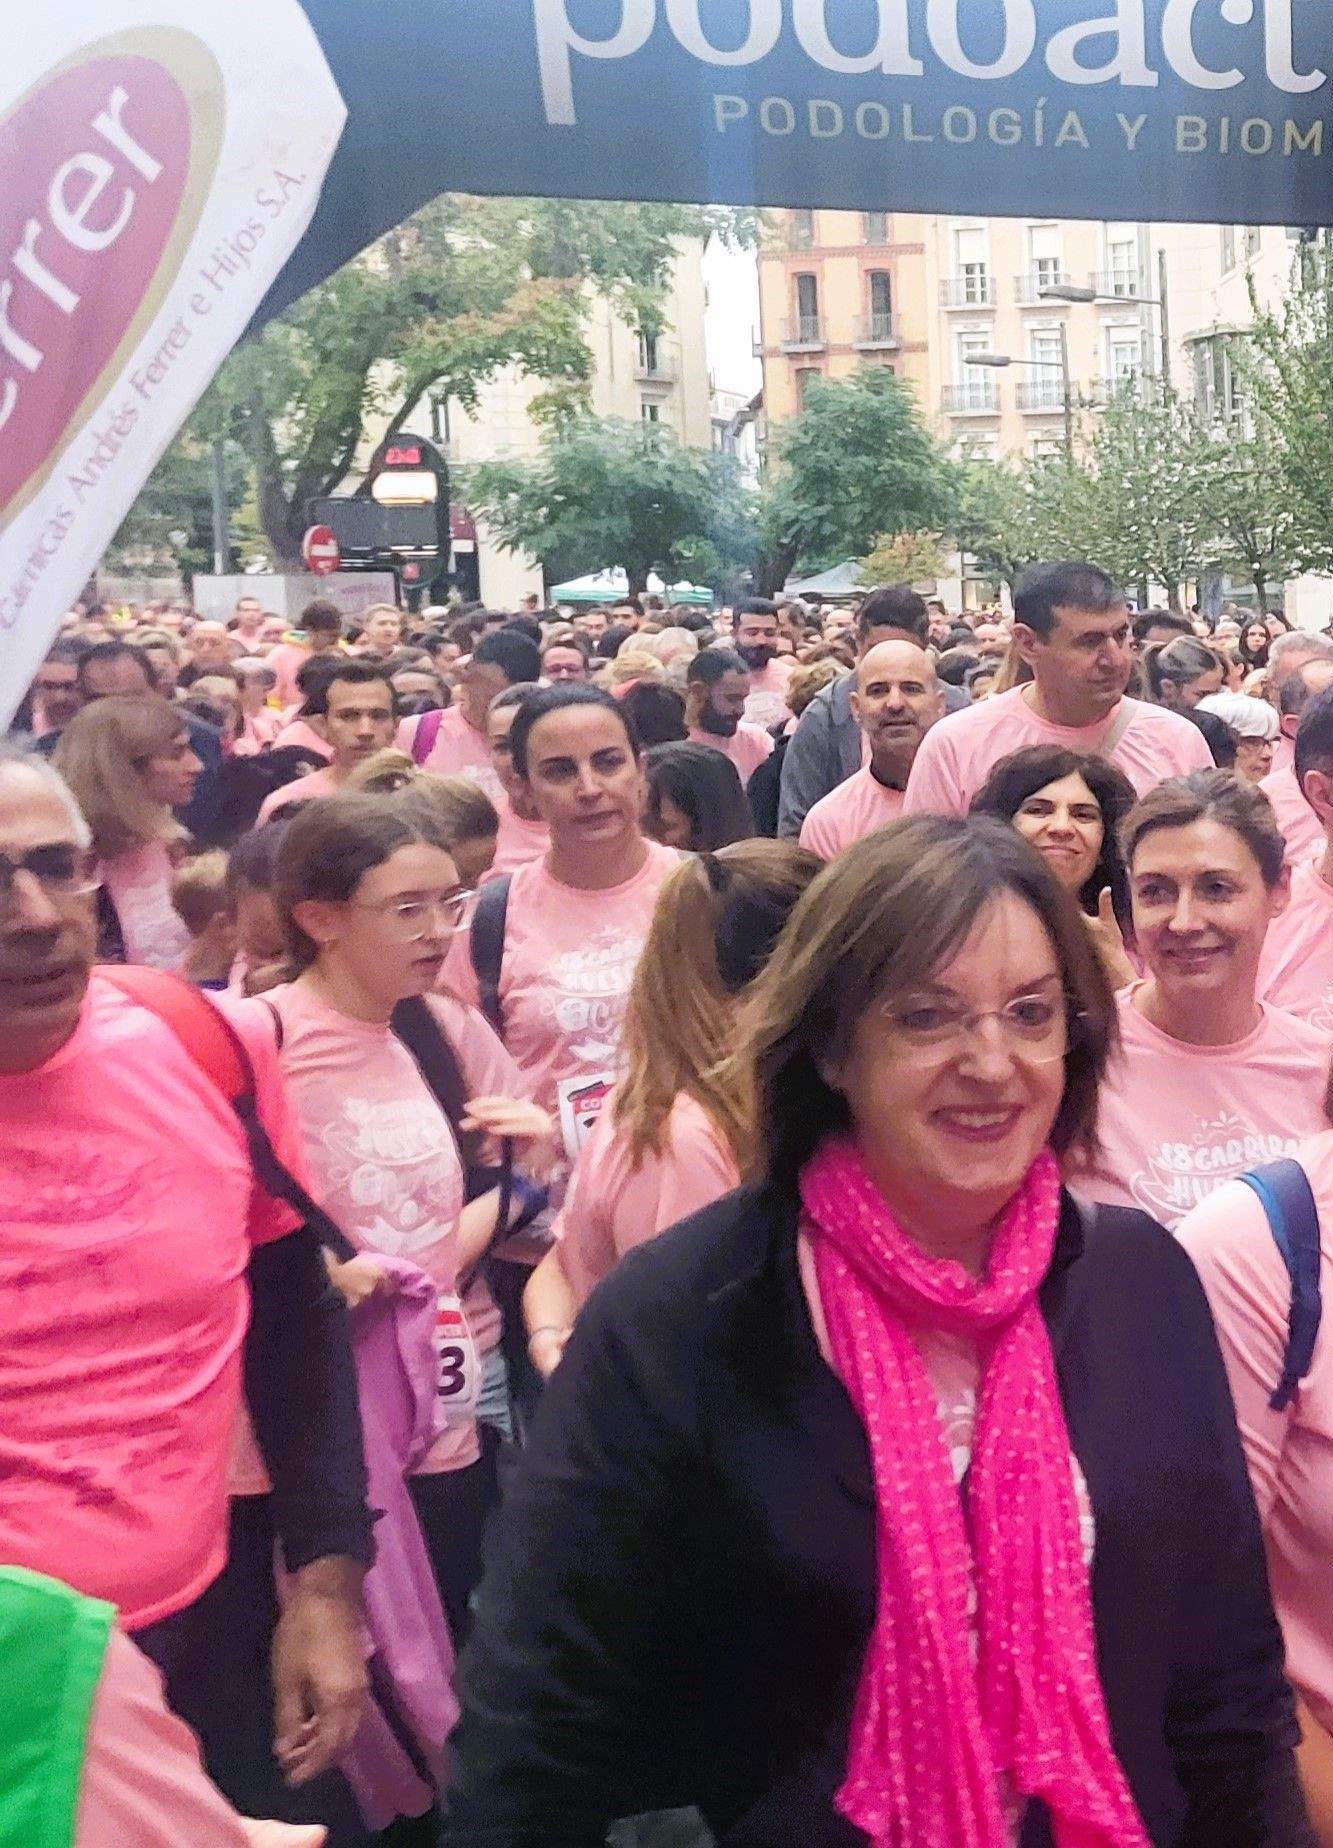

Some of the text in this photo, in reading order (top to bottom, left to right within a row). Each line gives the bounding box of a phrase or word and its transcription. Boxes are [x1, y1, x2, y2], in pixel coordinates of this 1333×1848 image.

[713, 94, 1090, 148] PODOLOGÍA
[1116, 112, 1148, 151] Y
[0, 85, 163, 432] rrer
[200, 215, 266, 292] Hijos
[191, 292, 212, 317] e
